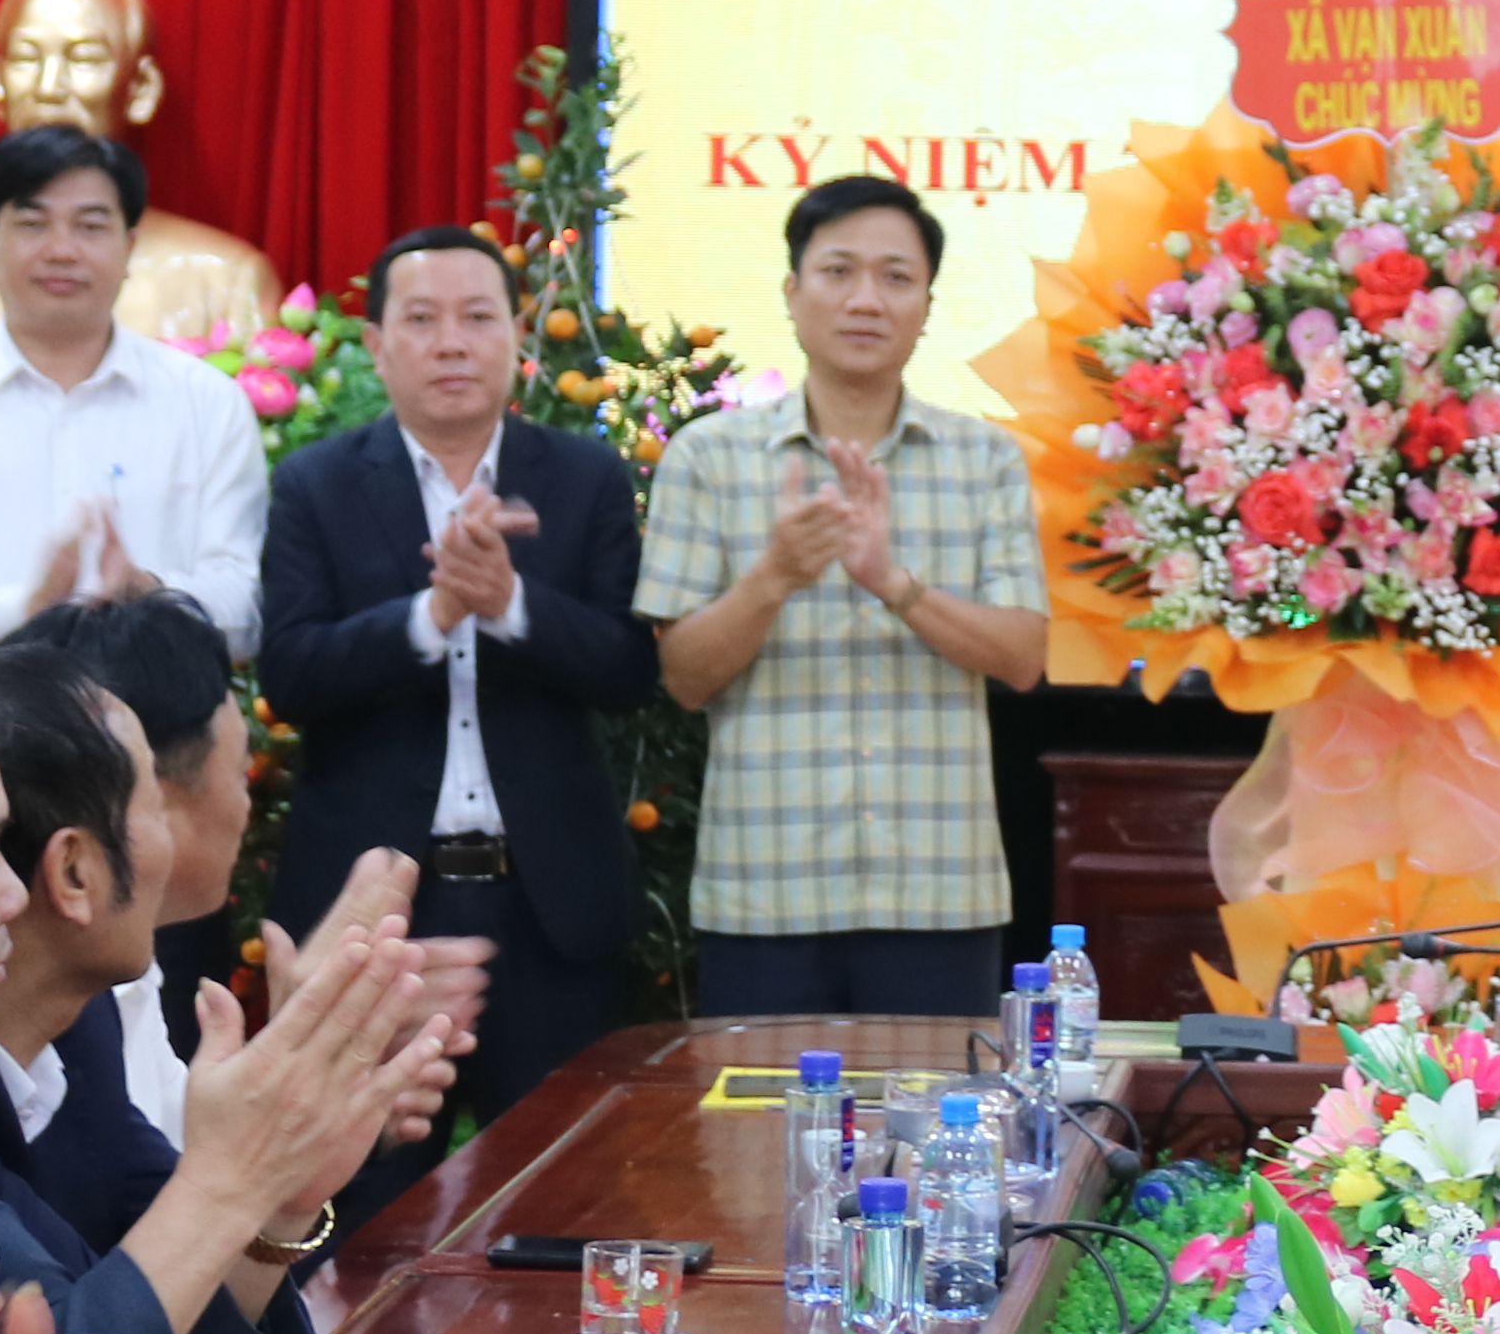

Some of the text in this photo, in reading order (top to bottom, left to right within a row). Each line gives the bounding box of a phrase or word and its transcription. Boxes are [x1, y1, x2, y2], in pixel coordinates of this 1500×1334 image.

[1333, 7, 1397, 75] VẠN
[1294, 67, 1380, 131] CHÚC
[704, 116, 829, 188] KỶ
[860, 128, 1091, 207] NIỆM
